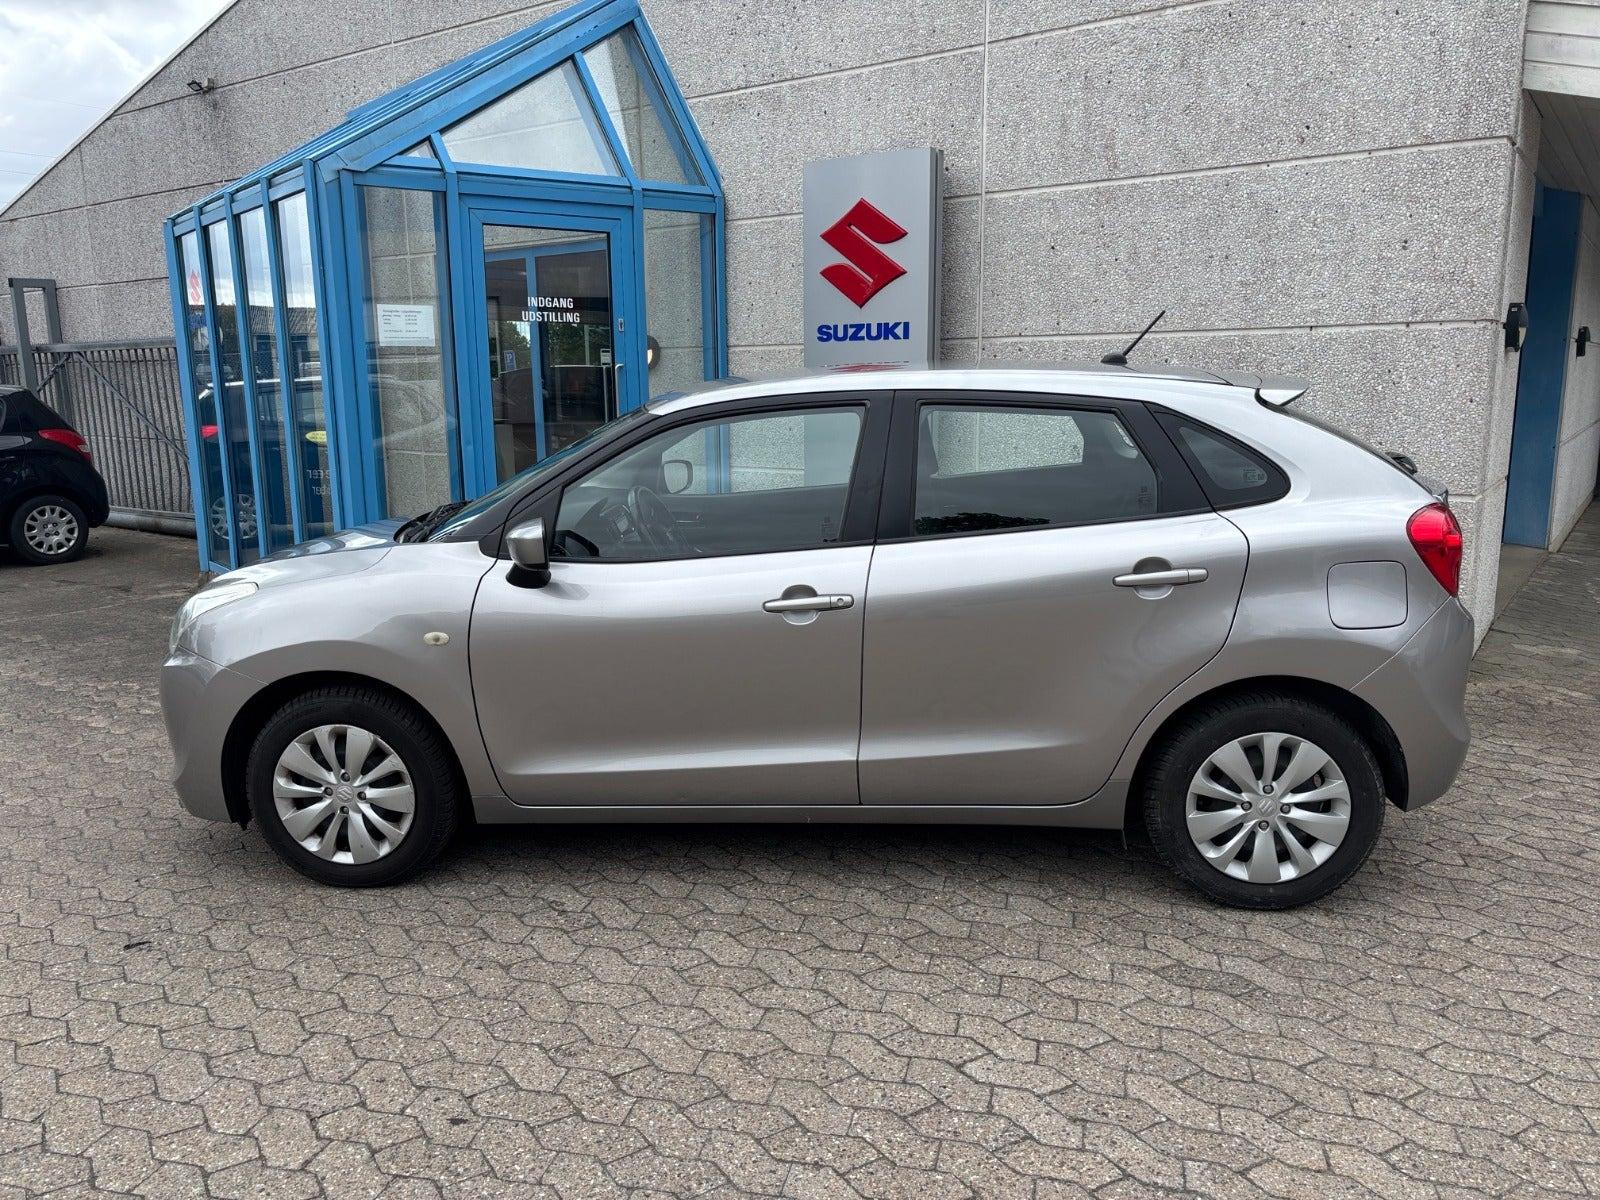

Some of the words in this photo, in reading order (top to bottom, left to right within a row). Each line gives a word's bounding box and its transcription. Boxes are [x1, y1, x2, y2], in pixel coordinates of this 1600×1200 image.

[527, 296, 574, 309] INDGANG
[521, 310, 580, 323] UDSTILLING
[816, 321, 910, 343] SUZUKI
